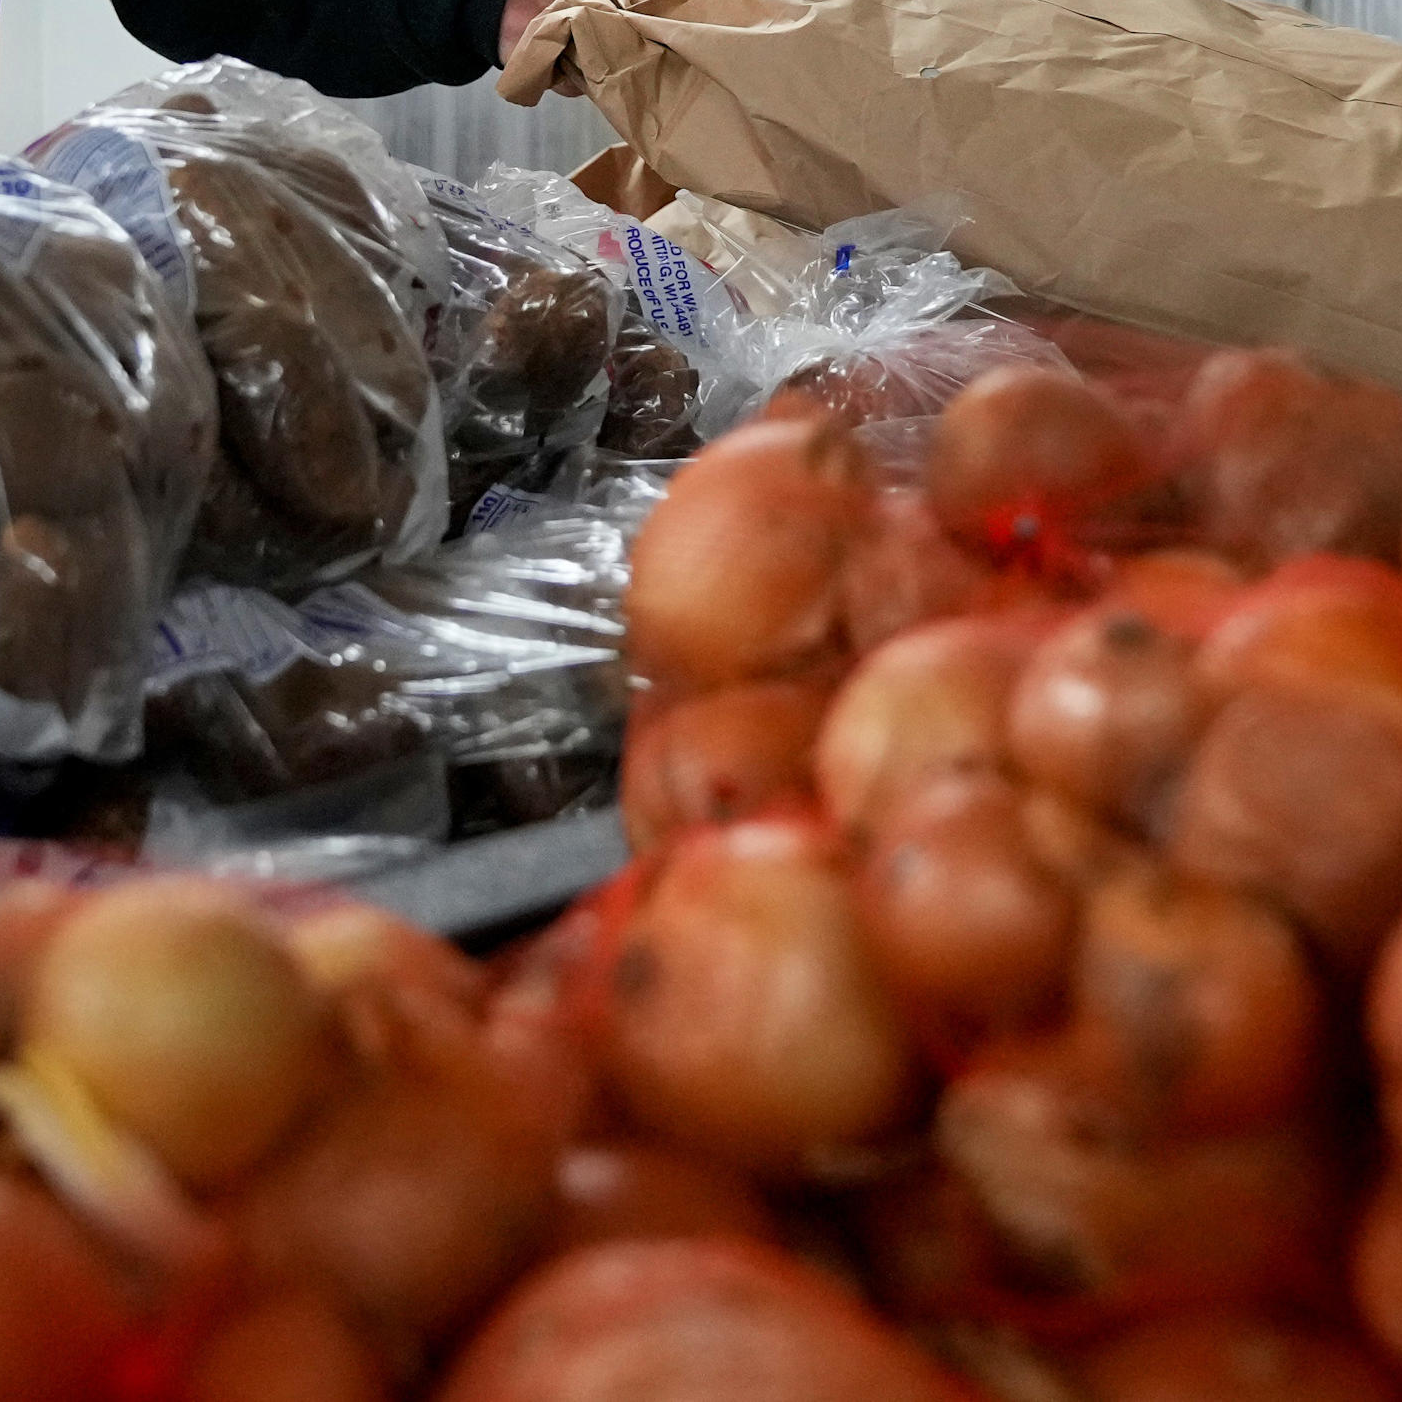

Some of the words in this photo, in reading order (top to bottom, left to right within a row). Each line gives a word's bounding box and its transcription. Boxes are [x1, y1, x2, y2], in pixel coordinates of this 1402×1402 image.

[626, 225, 653, 287] RODUCE
[643, 289, 661, 310] OF
[673, 259, 691, 291] FOR
